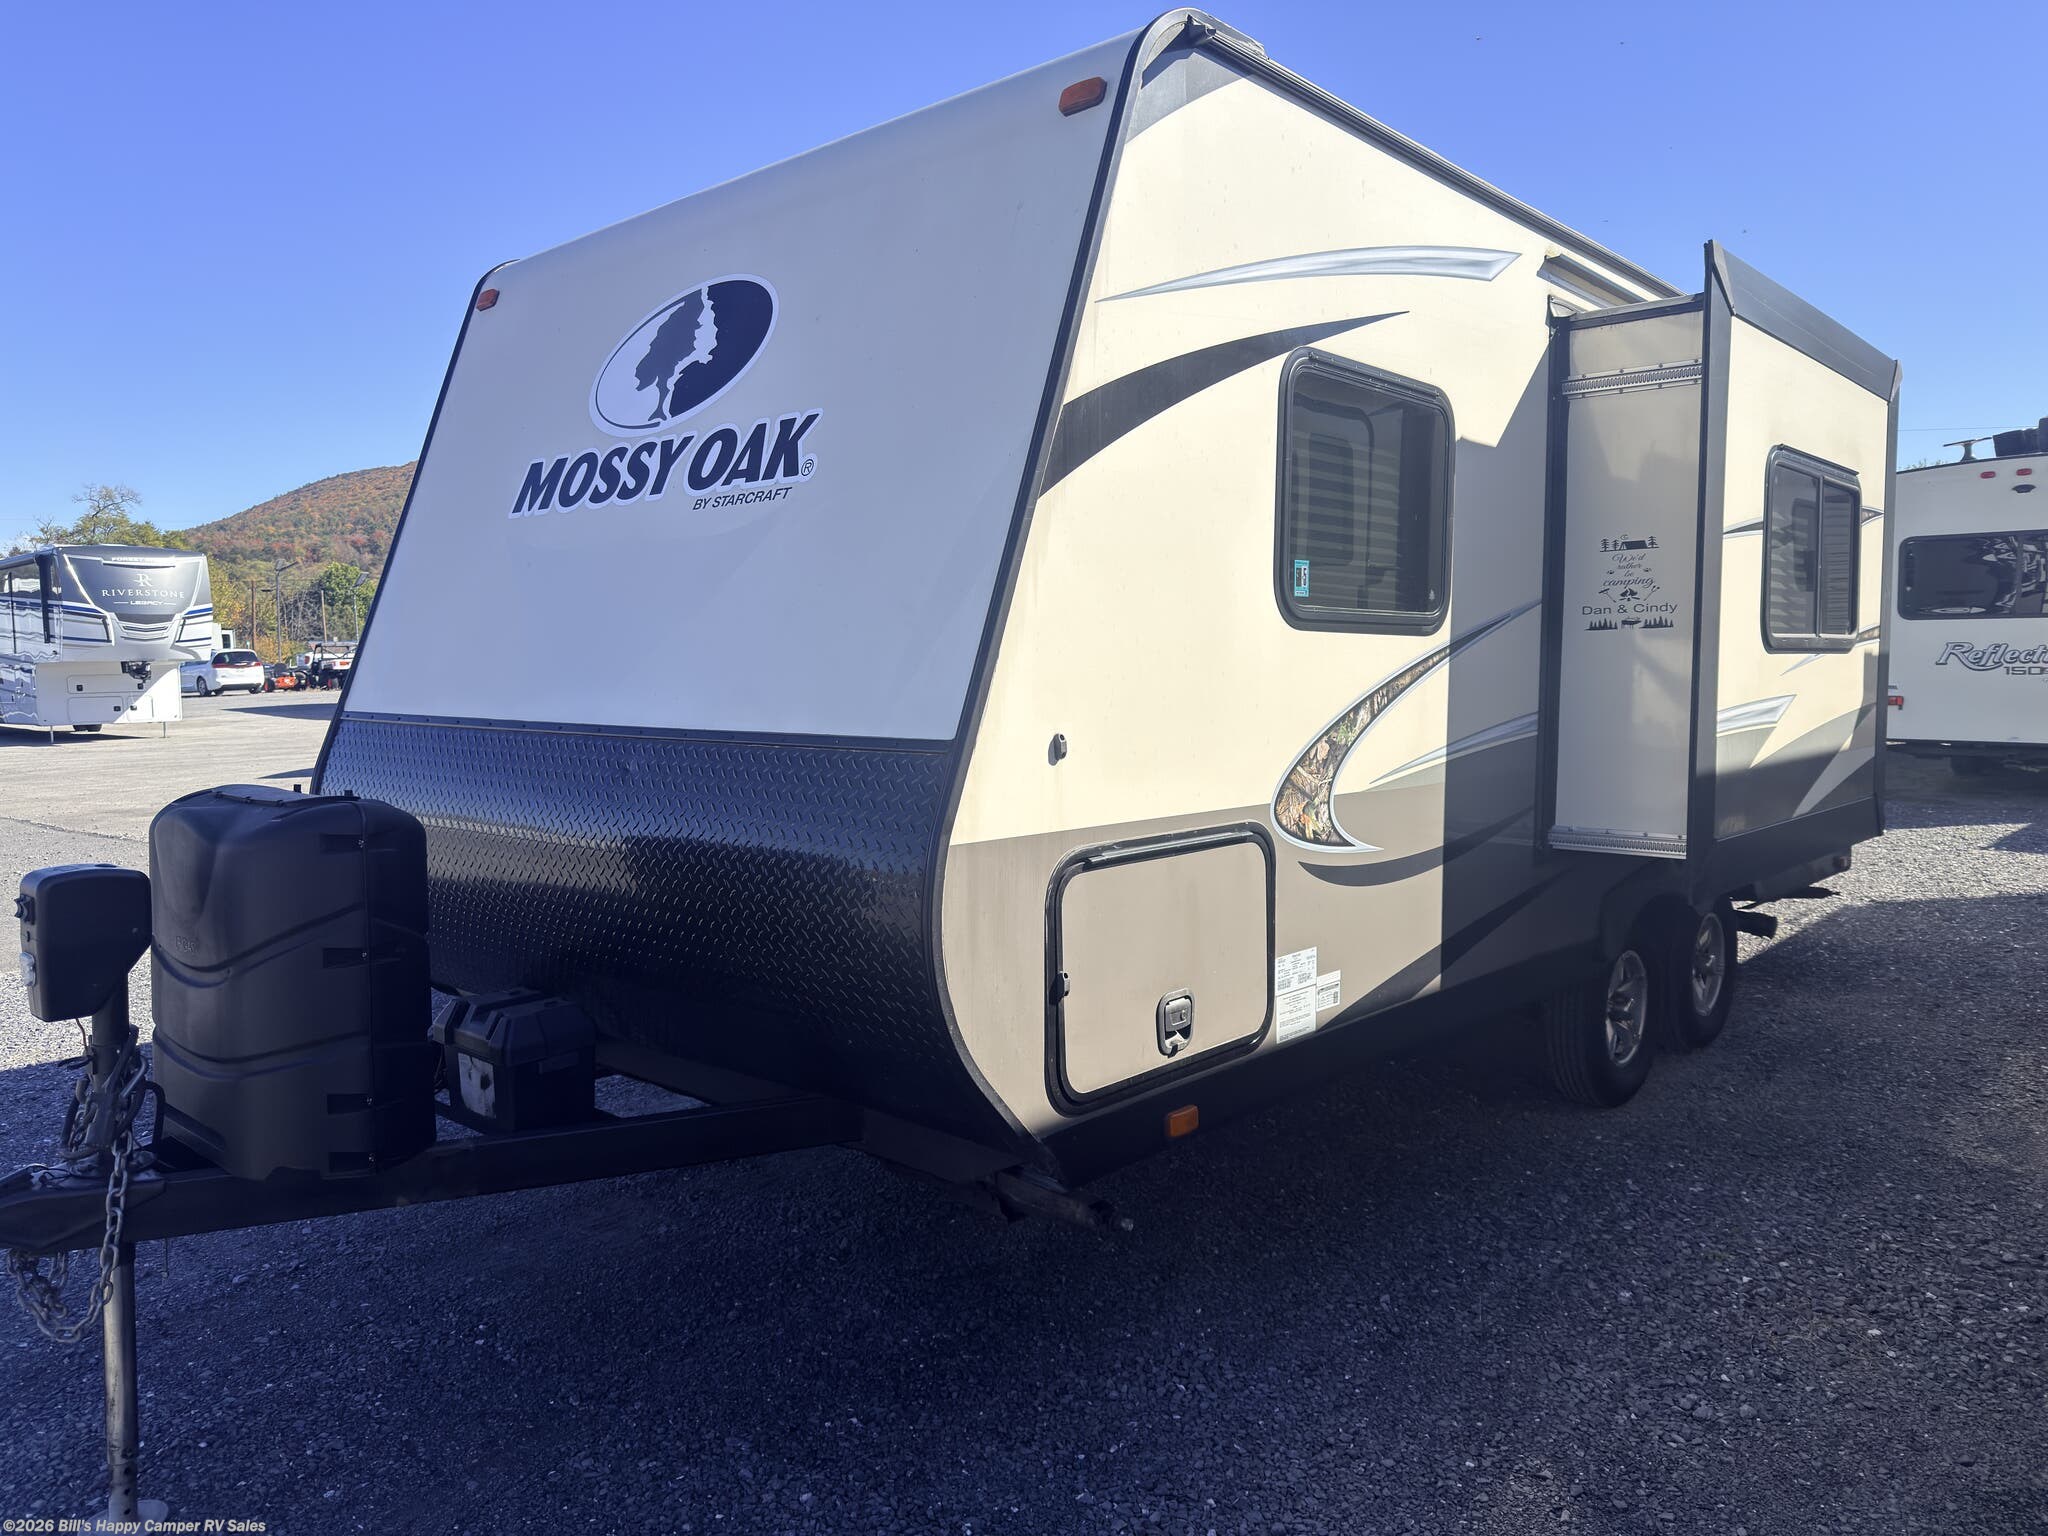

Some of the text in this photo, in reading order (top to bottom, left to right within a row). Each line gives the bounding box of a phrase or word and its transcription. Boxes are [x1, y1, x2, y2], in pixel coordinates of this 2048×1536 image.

[512, 435, 695, 514] MOSSY
[692, 487, 793, 511] BY STARCRAFT
[1603, 576, 1655, 589] camping
[102, 588, 185, 599] RIVERSTONE
[1582, 602, 1678, 615] Dan & Cindy
